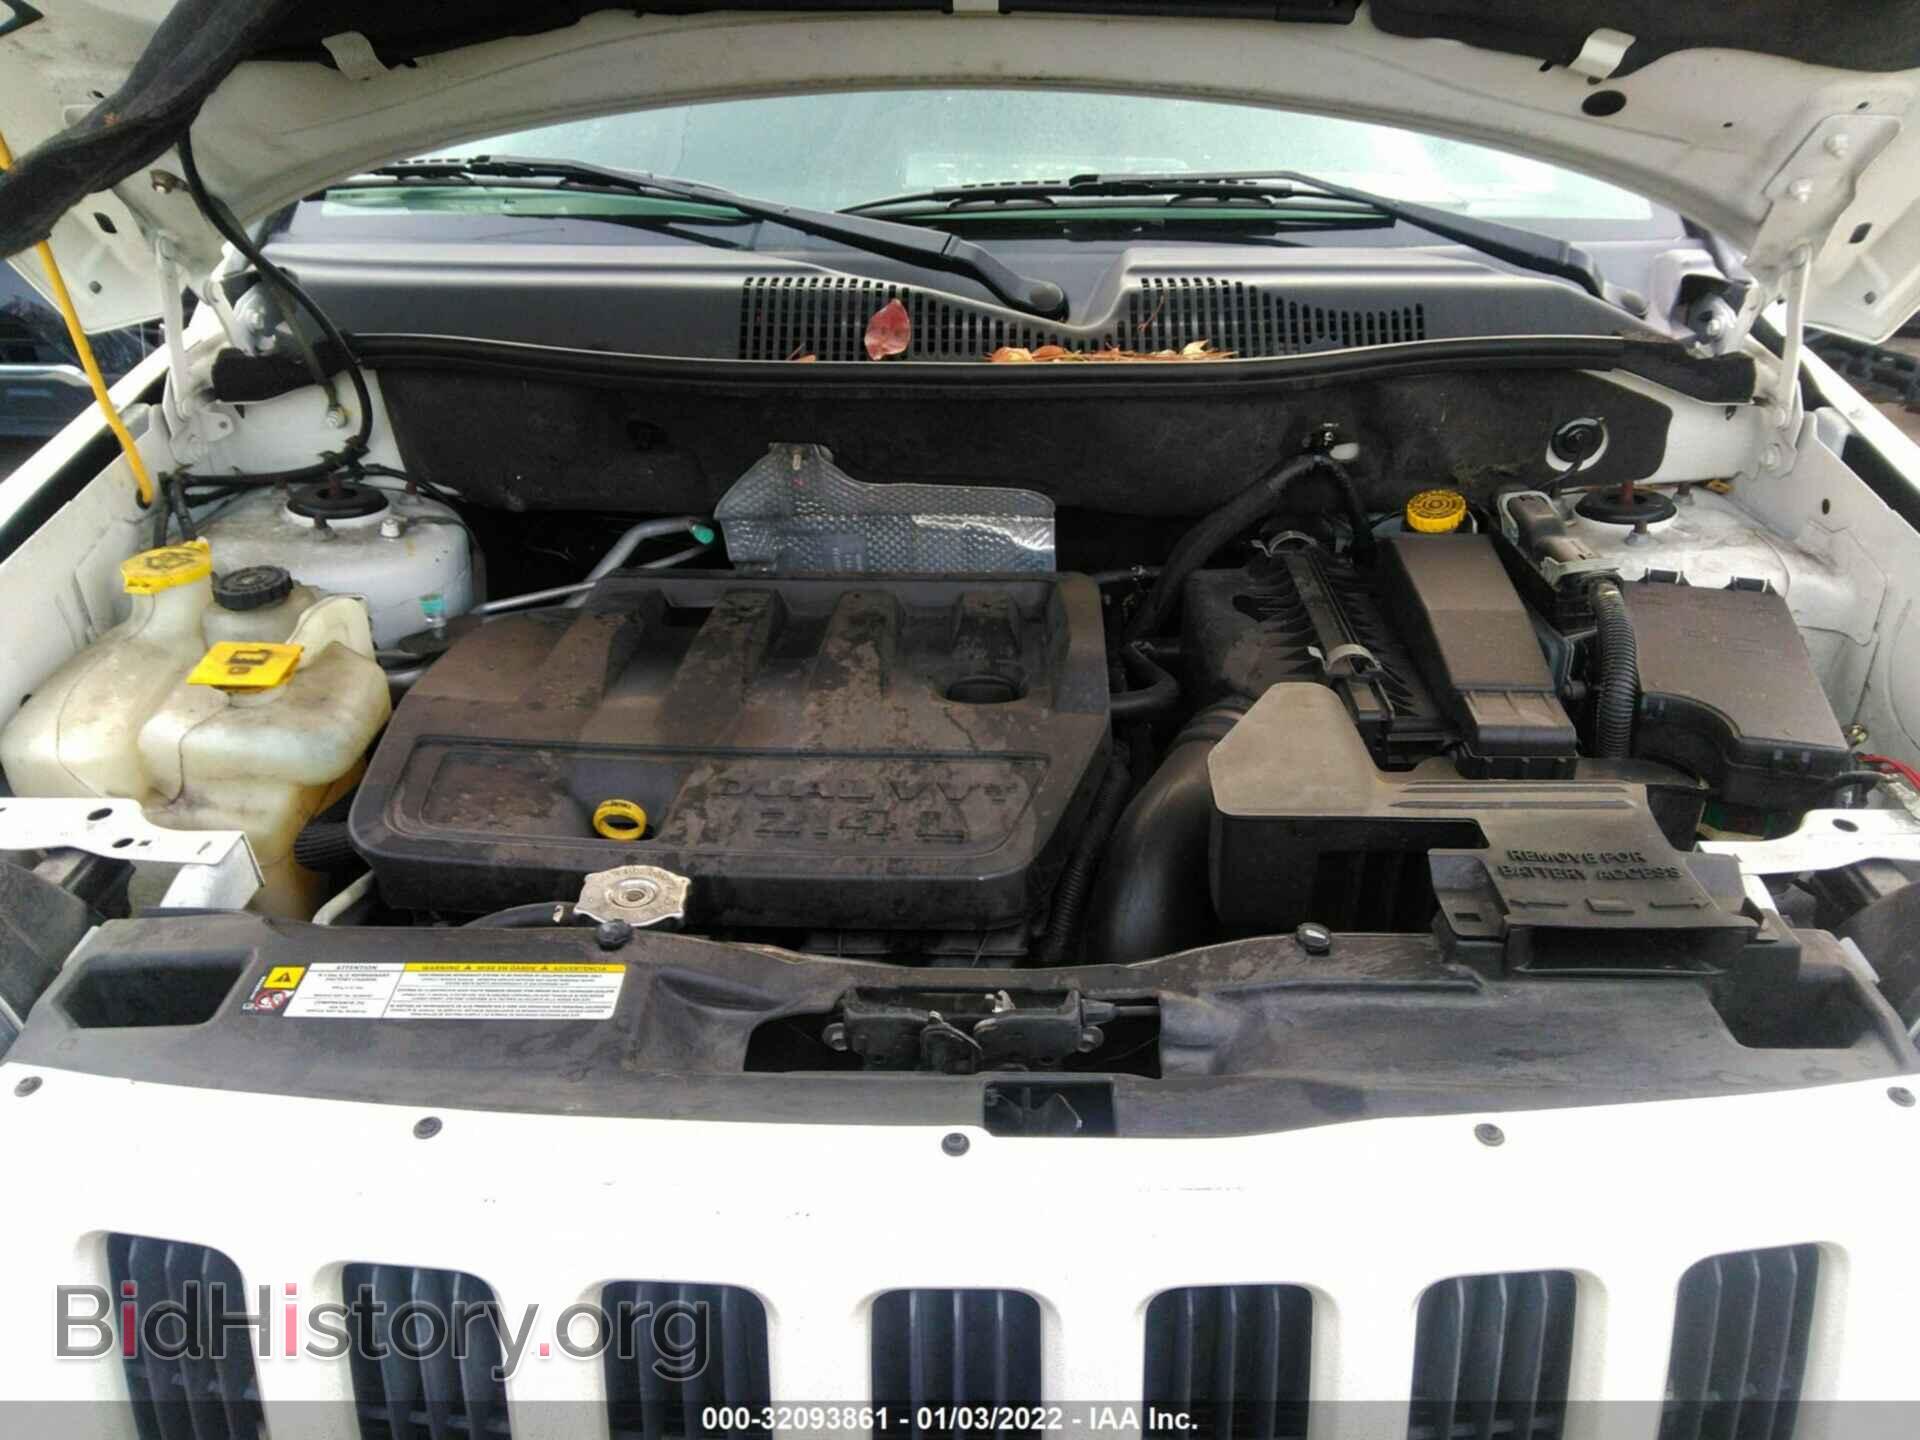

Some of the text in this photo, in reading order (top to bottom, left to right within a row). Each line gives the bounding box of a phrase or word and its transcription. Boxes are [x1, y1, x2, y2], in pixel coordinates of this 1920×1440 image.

[1505, 850, 1647, 865] REMOVE FOR
[1497, 865, 1684, 881] BATTERY ACCESS
